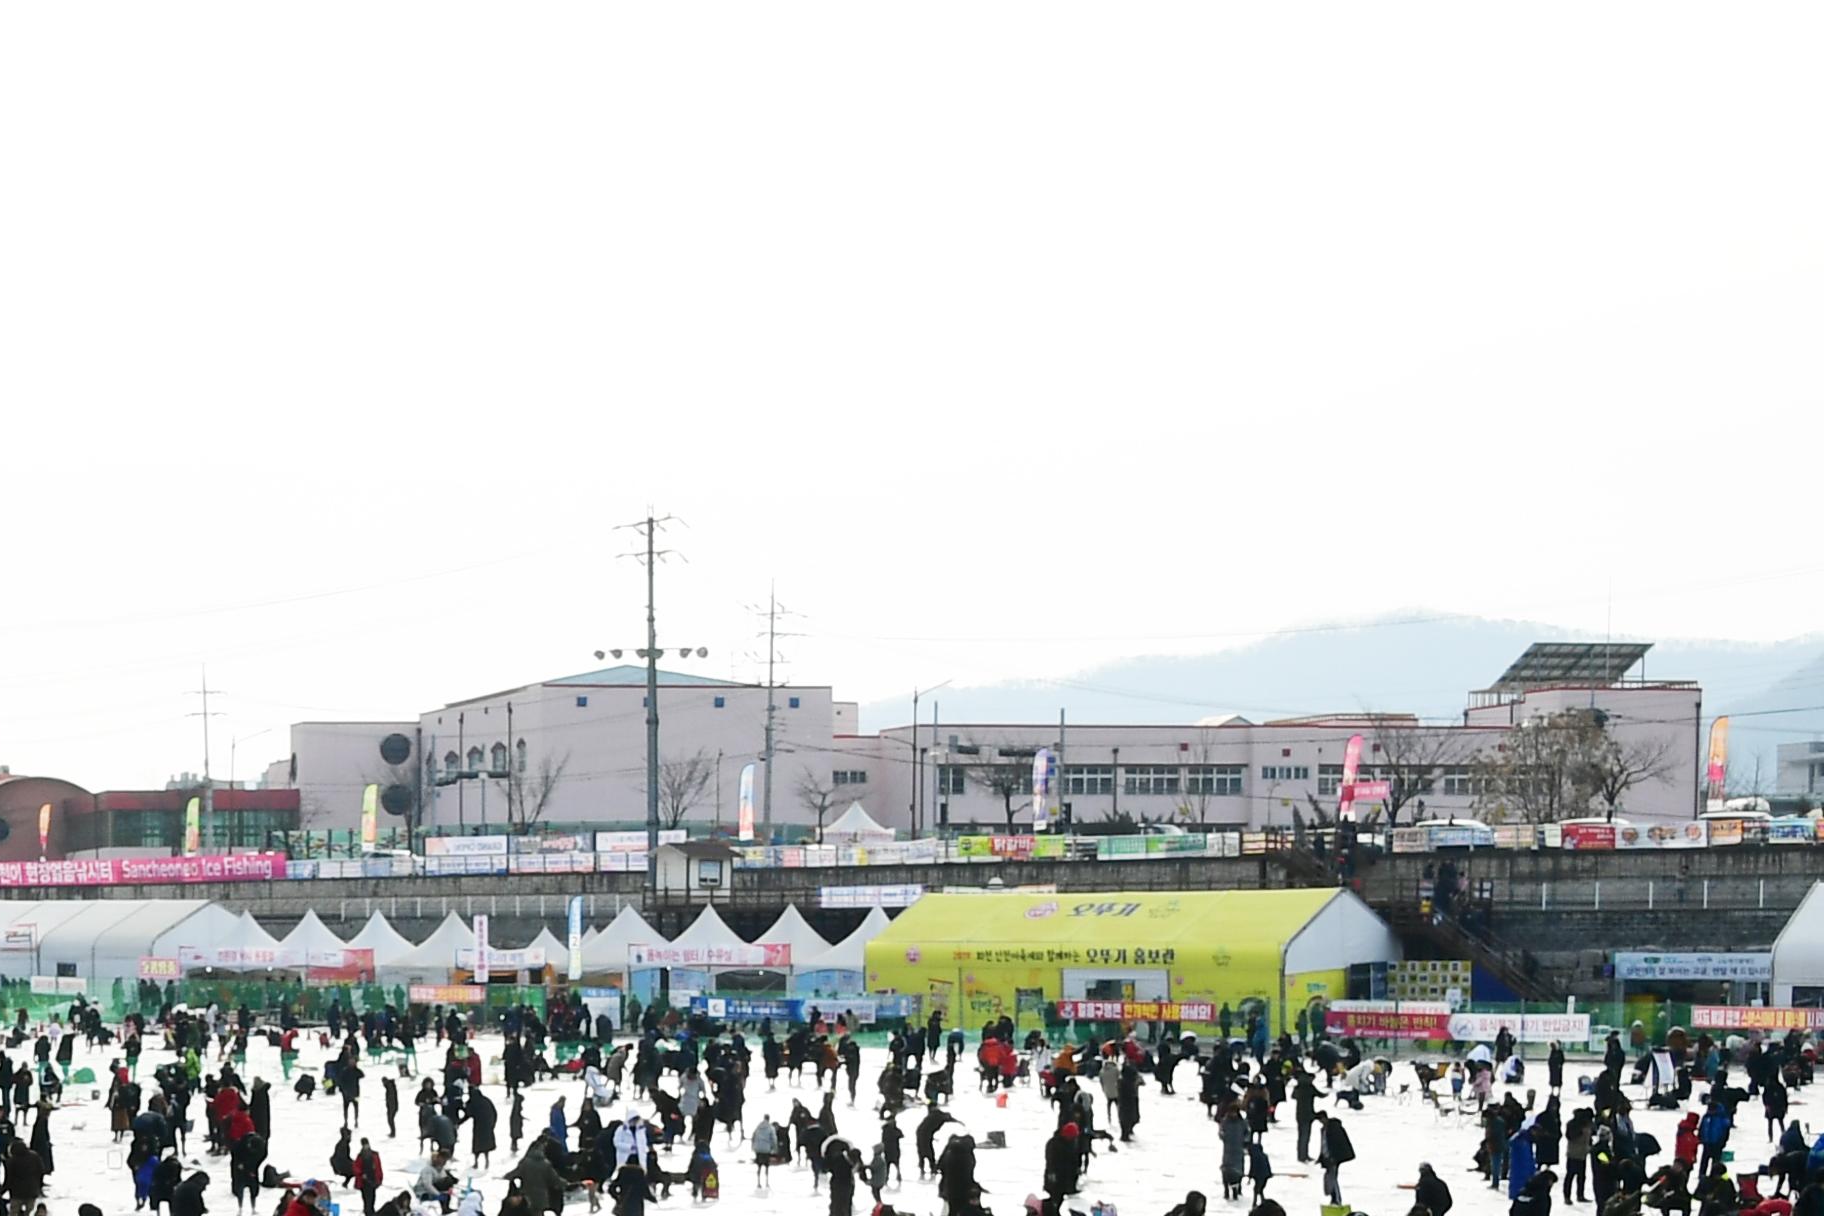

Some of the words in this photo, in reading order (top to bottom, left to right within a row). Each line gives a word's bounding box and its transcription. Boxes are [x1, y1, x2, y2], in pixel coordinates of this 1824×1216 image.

[223, 856, 273, 879] Fishing
[1067, 902, 1141, 918] 오뚜기
[1086, 949, 1127, 964] 오뚜기
[1133, 948, 1176, 965] 홍보관
